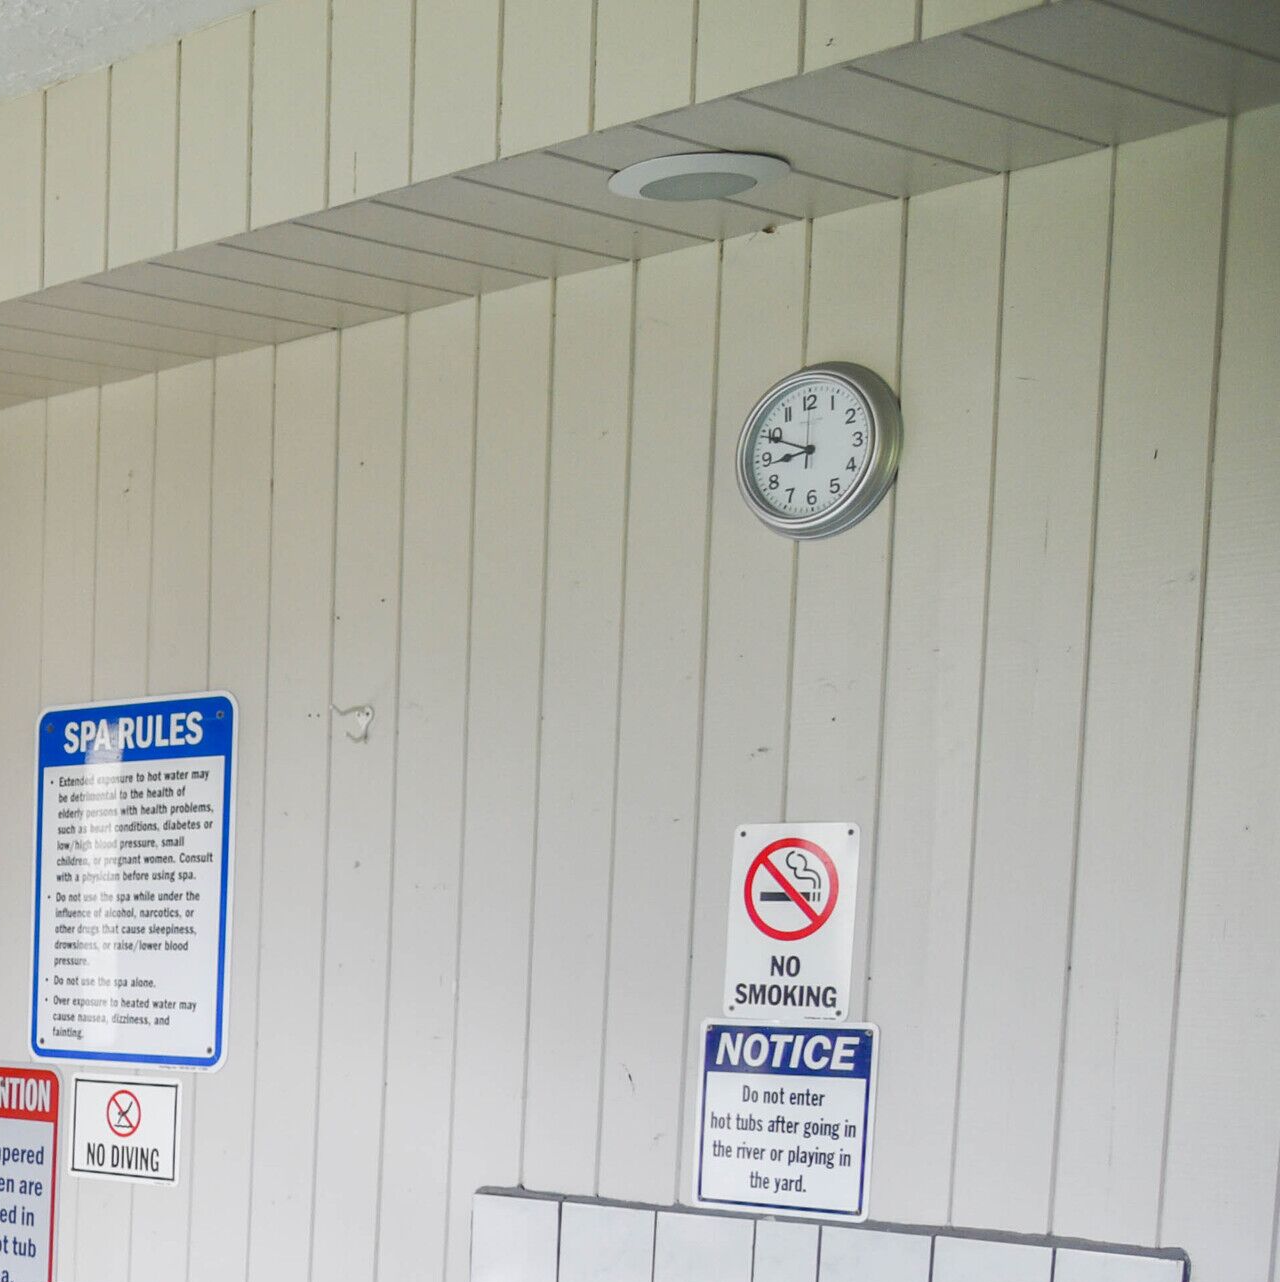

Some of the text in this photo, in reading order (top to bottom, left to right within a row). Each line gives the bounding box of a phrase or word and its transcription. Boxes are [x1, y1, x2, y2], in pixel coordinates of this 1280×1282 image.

[803, 395, 817, 411] 12
[831, 395, 834, 410] 1
[785, 407, 792, 422] 11
[845, 408, 856, 424] 2
[769, 427, 782, 444] 10
[852, 431, 863, 447] 3
[762, 452, 772, 467] 9
[846, 457, 857, 472] 4
[769, 475, 779, 490] 8
[830, 478, 840, 493] 5
[785, 488, 795, 503] 7
[807, 490, 817, 505] 6
[64, 711, 203, 754] SPA RULES
[136, 773, 144, 782] to
[147, 771, 161, 782] hot
[164, 771, 188, 780] water
[191, 770, 209, 781] may
[59, 785, 185, 803] be to the health of
[58, 802, 213, 820] elderly with health problems,
[58, 825, 75, 834] such
[163, 821, 200, 830] diabetes
[161, 836, 184, 847] small
[144, 855, 175, 865] women.
[179, 853, 213, 863] Consult
[57, 872, 72, 882] with
[123, 871, 148, 880] before
[152, 871, 175, 882] using
[56, 891, 200, 902] Do not spa while under the
[55, 925, 74, 933] other
[122, 926, 145, 934] cause
[165, 941, 188, 950] blood
[770, 956, 800, 977] NO
[54, 976, 156, 988] Do not spa alone.
[734, 983, 837, 1008] SMOKING
[54, 996, 69, 1005] Over
[121, 998, 149, 1008] heated
[153, 1000, 176, 1009] water
[179, 1002, 196, 1012] may
[53, 1012, 75, 1021] cause
[154, 1016, 169, 1025] and
[716, 1032, 859, 1071] NOTICE
[743, 1085, 825, 1106] Do not enter
[711, 1111, 856, 1140] hot tubs after going in
[87, 1142, 159, 1172] NO DIVING
[713, 1140, 851, 1168] the river or playing in
[20, 1178, 43, 1196] are
[750, 1171, 806, 1193] the yard.
[21, 1207, 34, 1227] in
[12, 1237, 37, 1258] tub
